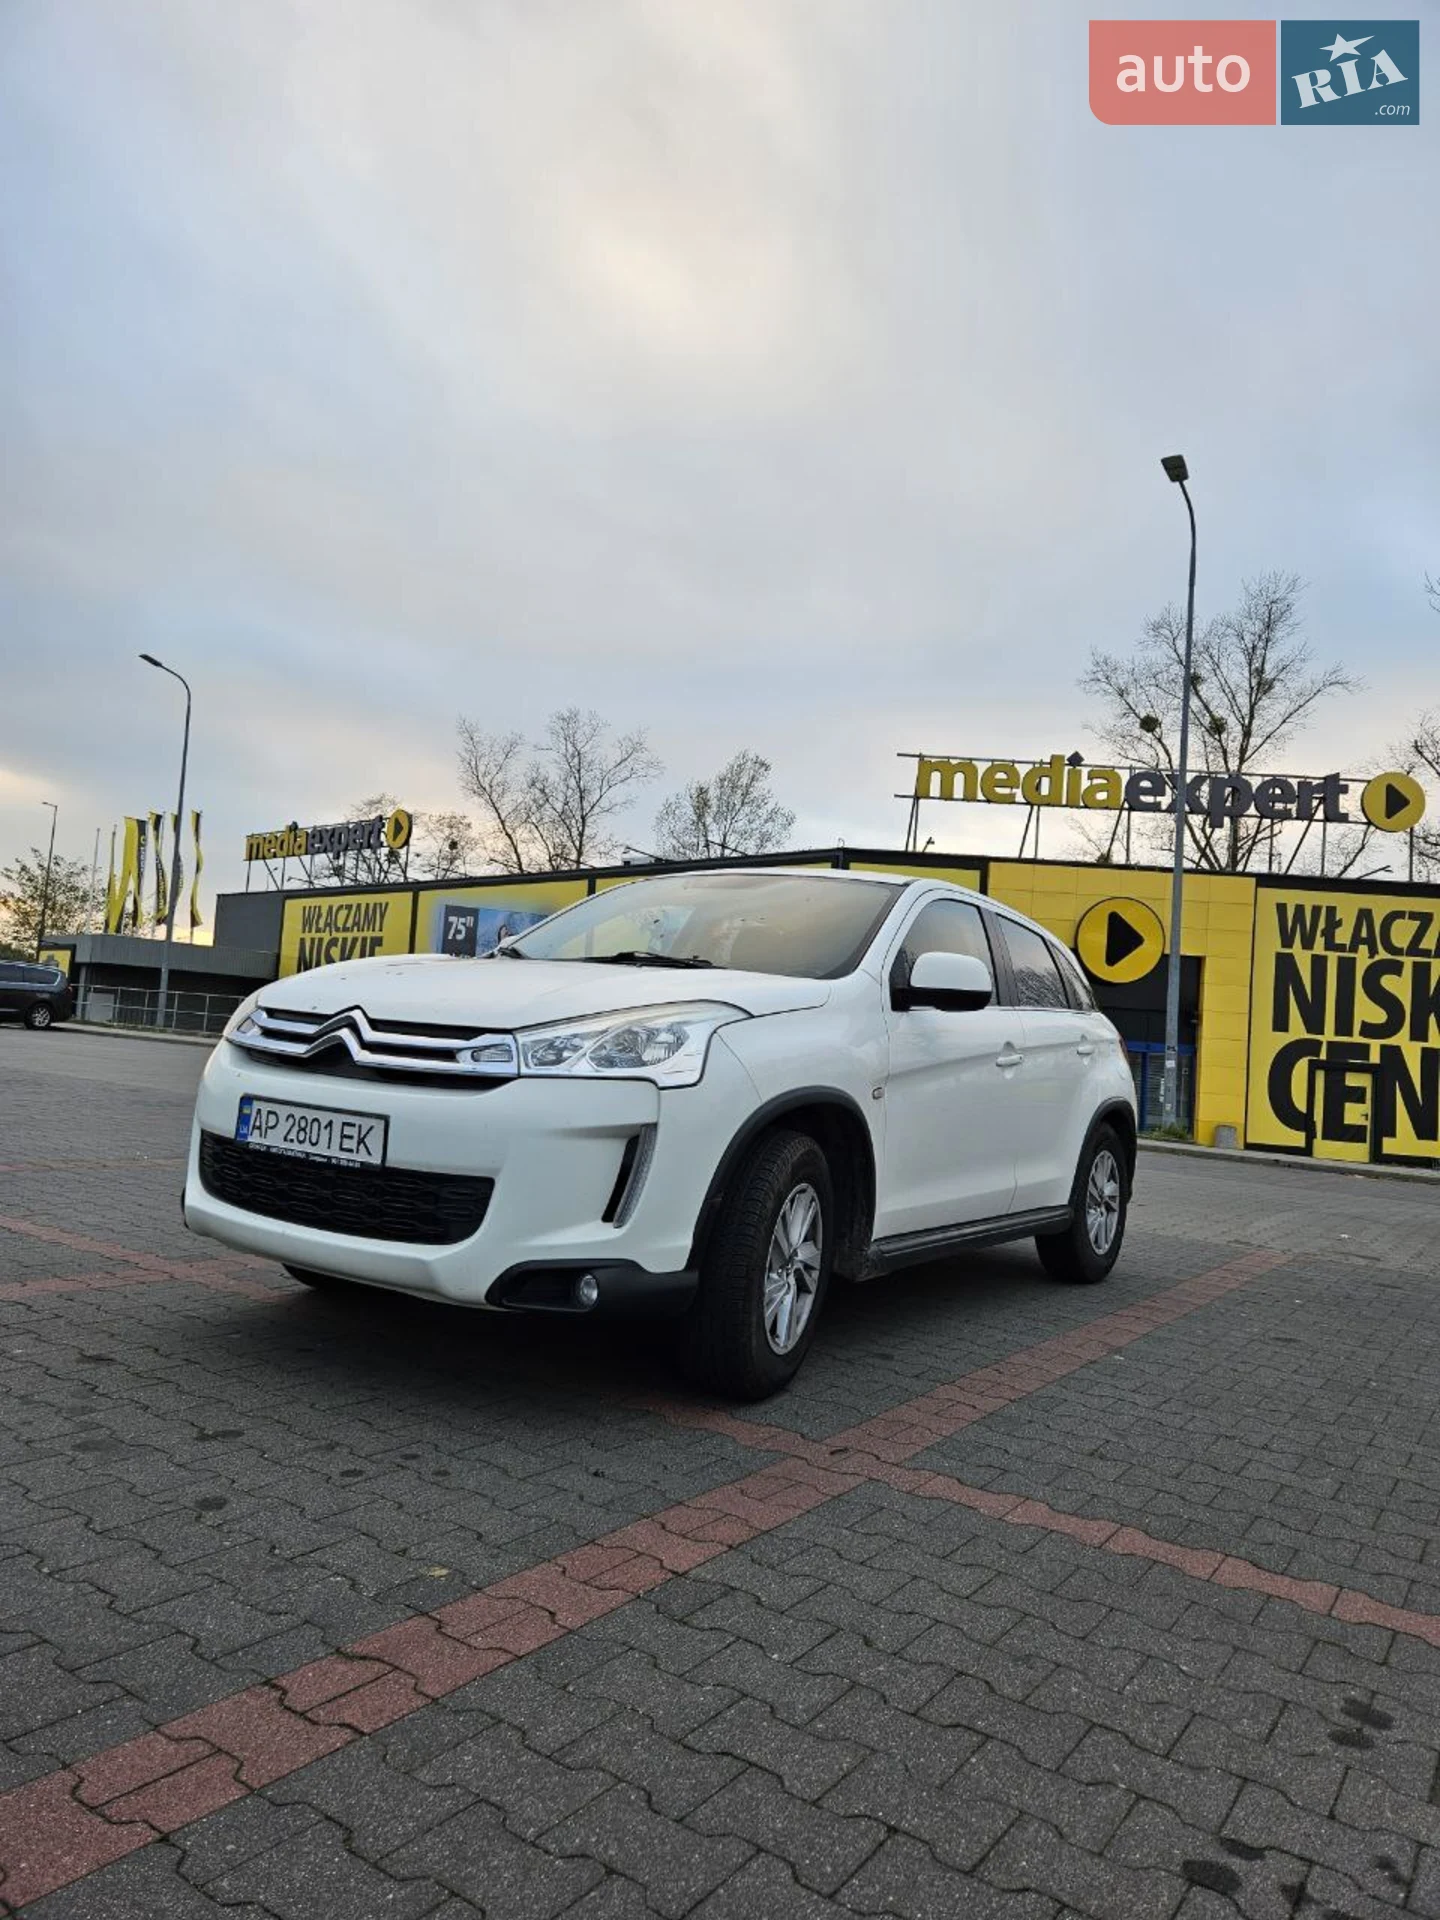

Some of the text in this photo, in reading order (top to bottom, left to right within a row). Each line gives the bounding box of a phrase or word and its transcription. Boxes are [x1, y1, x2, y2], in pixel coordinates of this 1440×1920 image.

[301, 901, 389, 936] WŁĄCZAMY
[1275, 902, 1440, 959] WŁĄCZ
[250, 1108, 279, 1139] AP
[283, 1113, 334, 1149] 2801
[339, 1121, 375, 1156] EK
